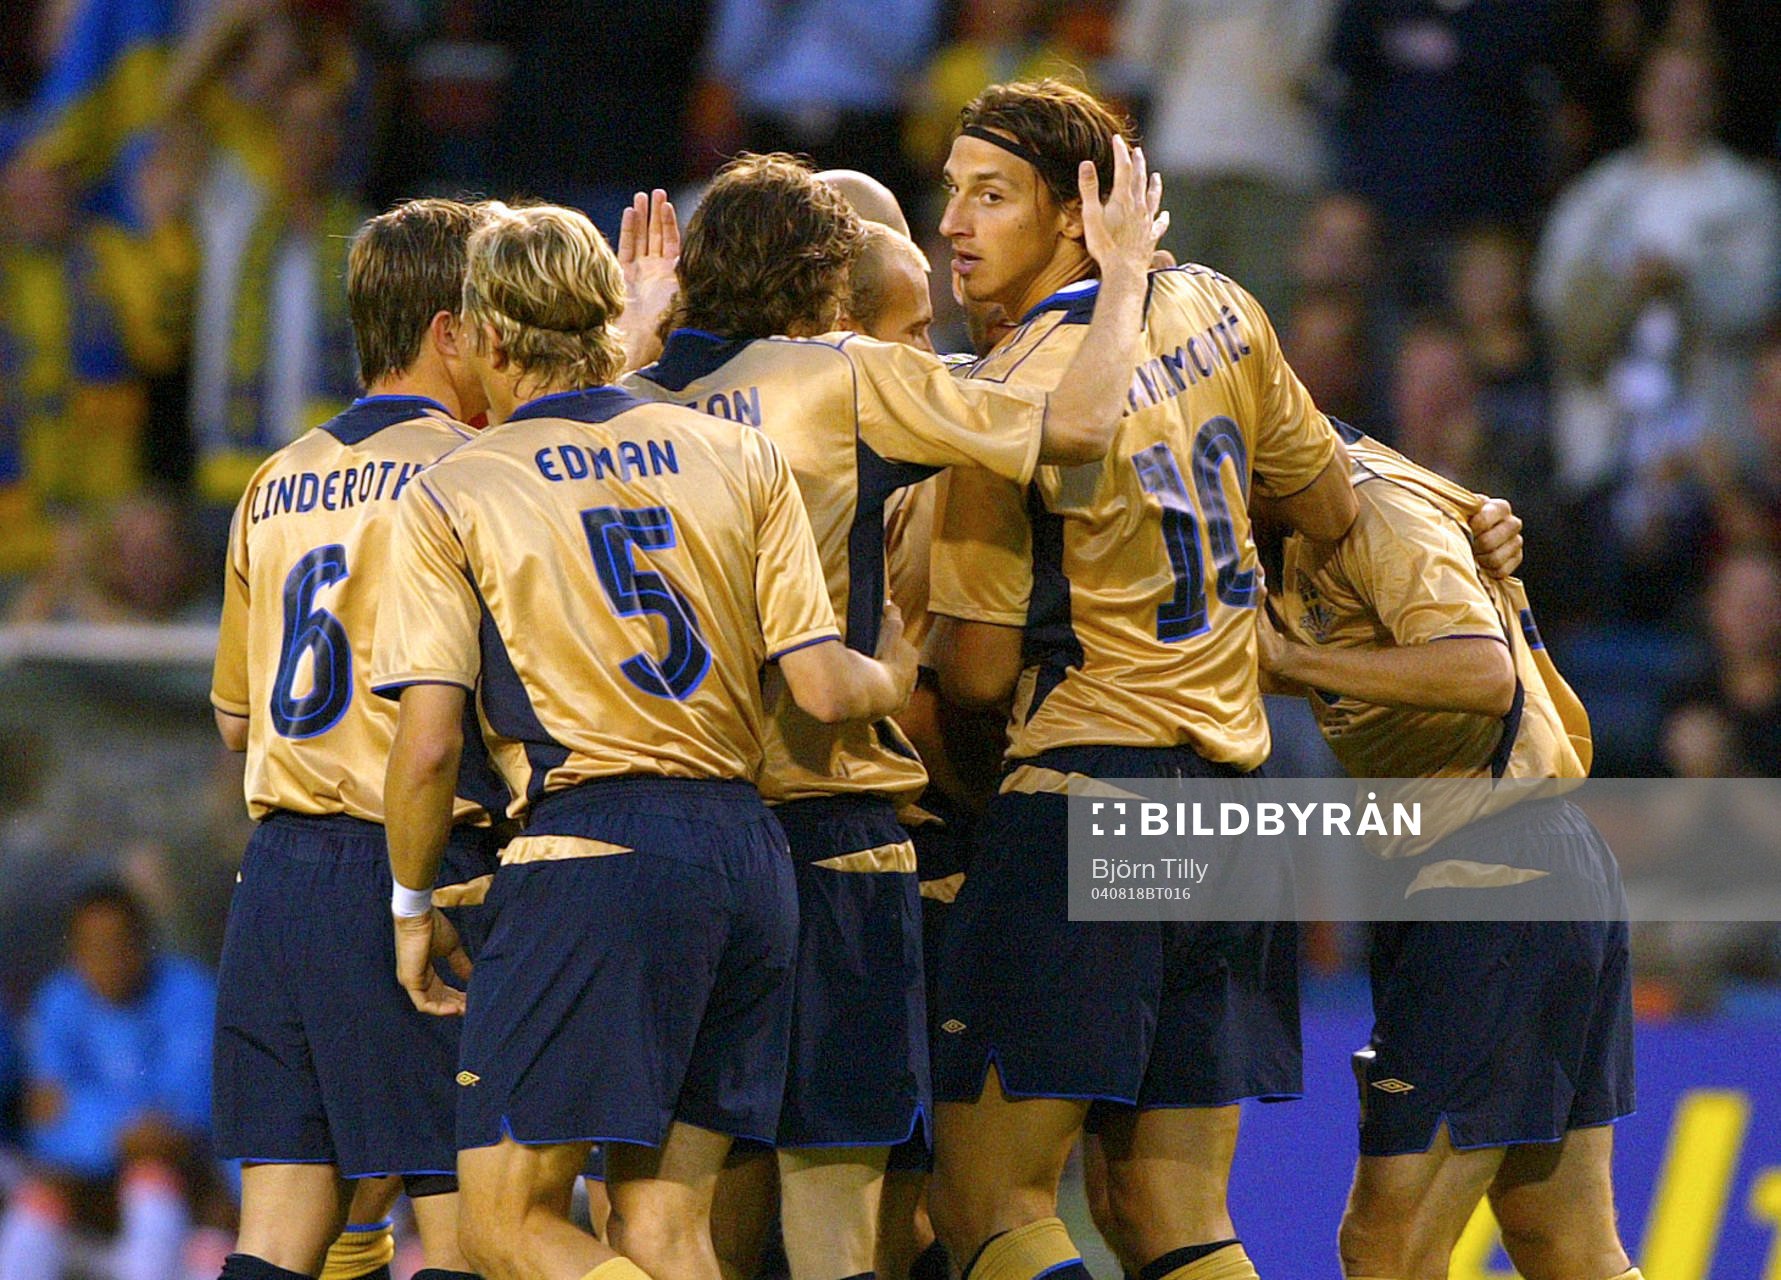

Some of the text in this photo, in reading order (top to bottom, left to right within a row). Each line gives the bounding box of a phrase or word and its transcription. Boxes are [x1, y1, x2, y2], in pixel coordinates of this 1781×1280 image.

[251, 460, 426, 524] LINDEROTH
[534, 439, 680, 482] EDMAN
[1131, 415, 1258, 643] 10
[270, 543, 353, 740] 6
[580, 505, 712, 702] 5
